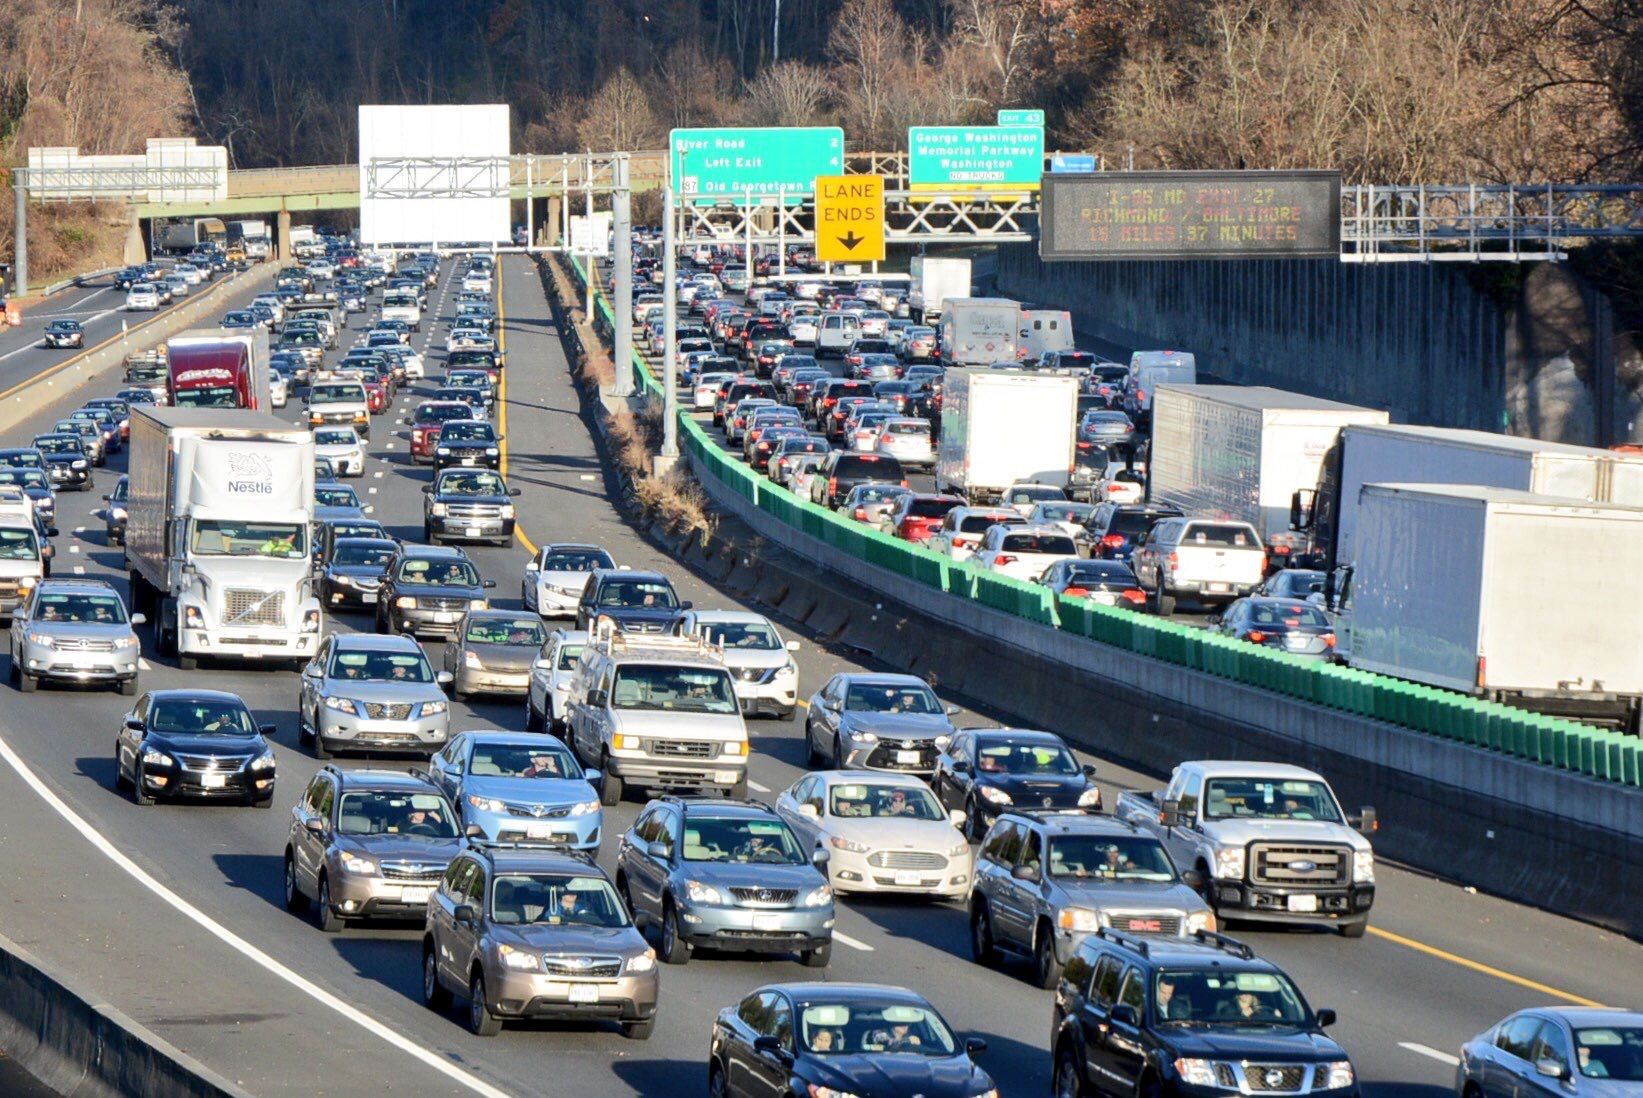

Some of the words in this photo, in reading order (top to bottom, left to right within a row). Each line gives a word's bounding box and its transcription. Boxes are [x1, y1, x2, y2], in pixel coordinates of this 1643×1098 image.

[1025, 113, 1041, 123] 43
[715, 138, 745, 149] Road
[916, 133, 959, 144] George
[964, 133, 1037, 144] Washington
[918, 146, 976, 156] Memorial
[981, 146, 1035, 157] Parkway
[705, 158, 730, 168] Left
[736, 157, 762, 168] Exit
[940, 159, 1014, 170] Washington
[967, 172, 1004, 180] TRUCKS
[705, 181, 726, 192] Old
[732, 181, 804, 193] Georgetown
[824, 184, 875, 199] LANE
[824, 207, 876, 222] ENDS
